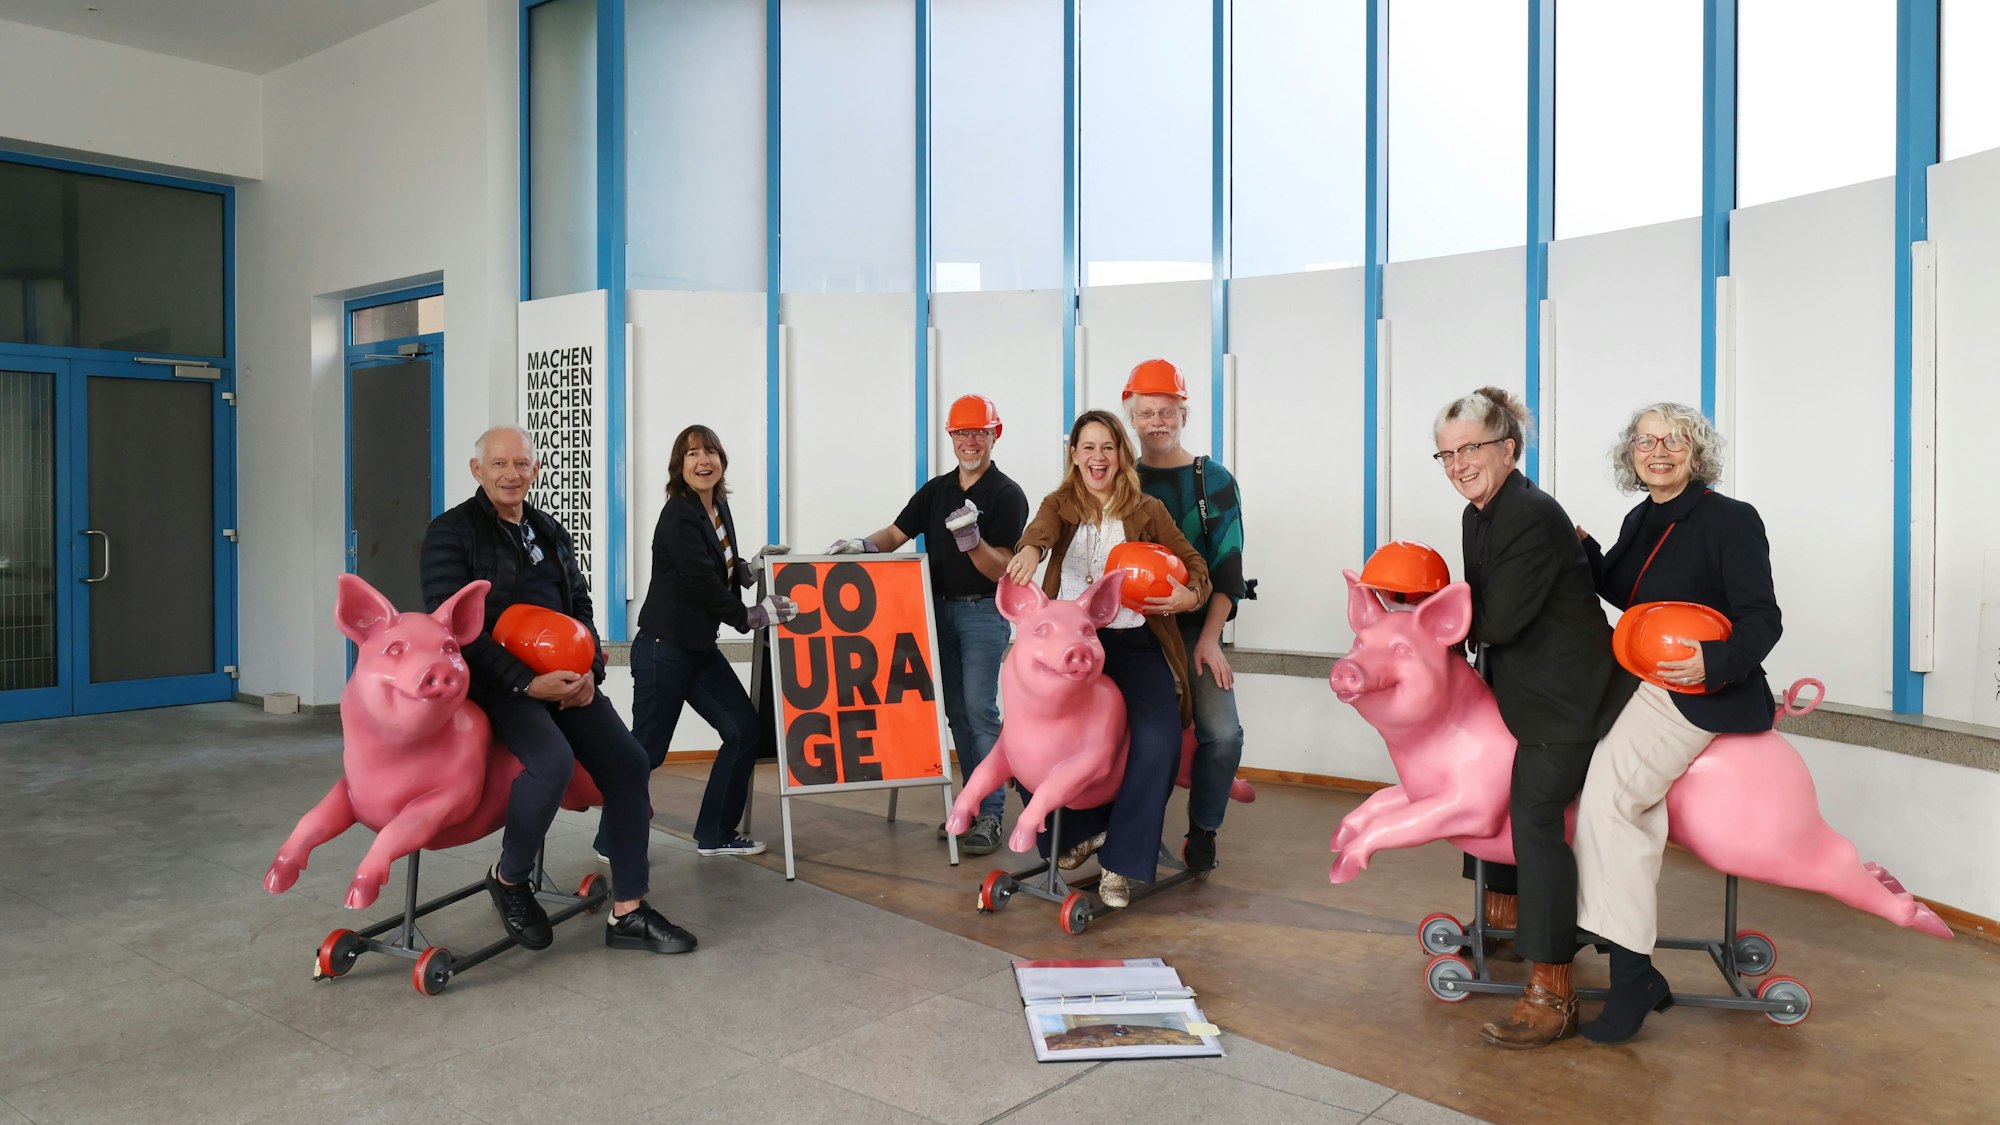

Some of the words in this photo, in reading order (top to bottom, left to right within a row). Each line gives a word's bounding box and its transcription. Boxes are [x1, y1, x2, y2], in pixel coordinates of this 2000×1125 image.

[527, 346, 592, 371] MACHEN
[527, 367, 592, 390] MACHEN
[527, 387, 592, 410] MACHEN
[527, 408, 592, 430] MACHEN
[537, 449, 591, 470] ACHEN
[527, 491, 591, 510] MACHEN
[774, 562, 877, 635] CO
[778, 633, 935, 710] URA
[786, 710, 883, 785] GE
